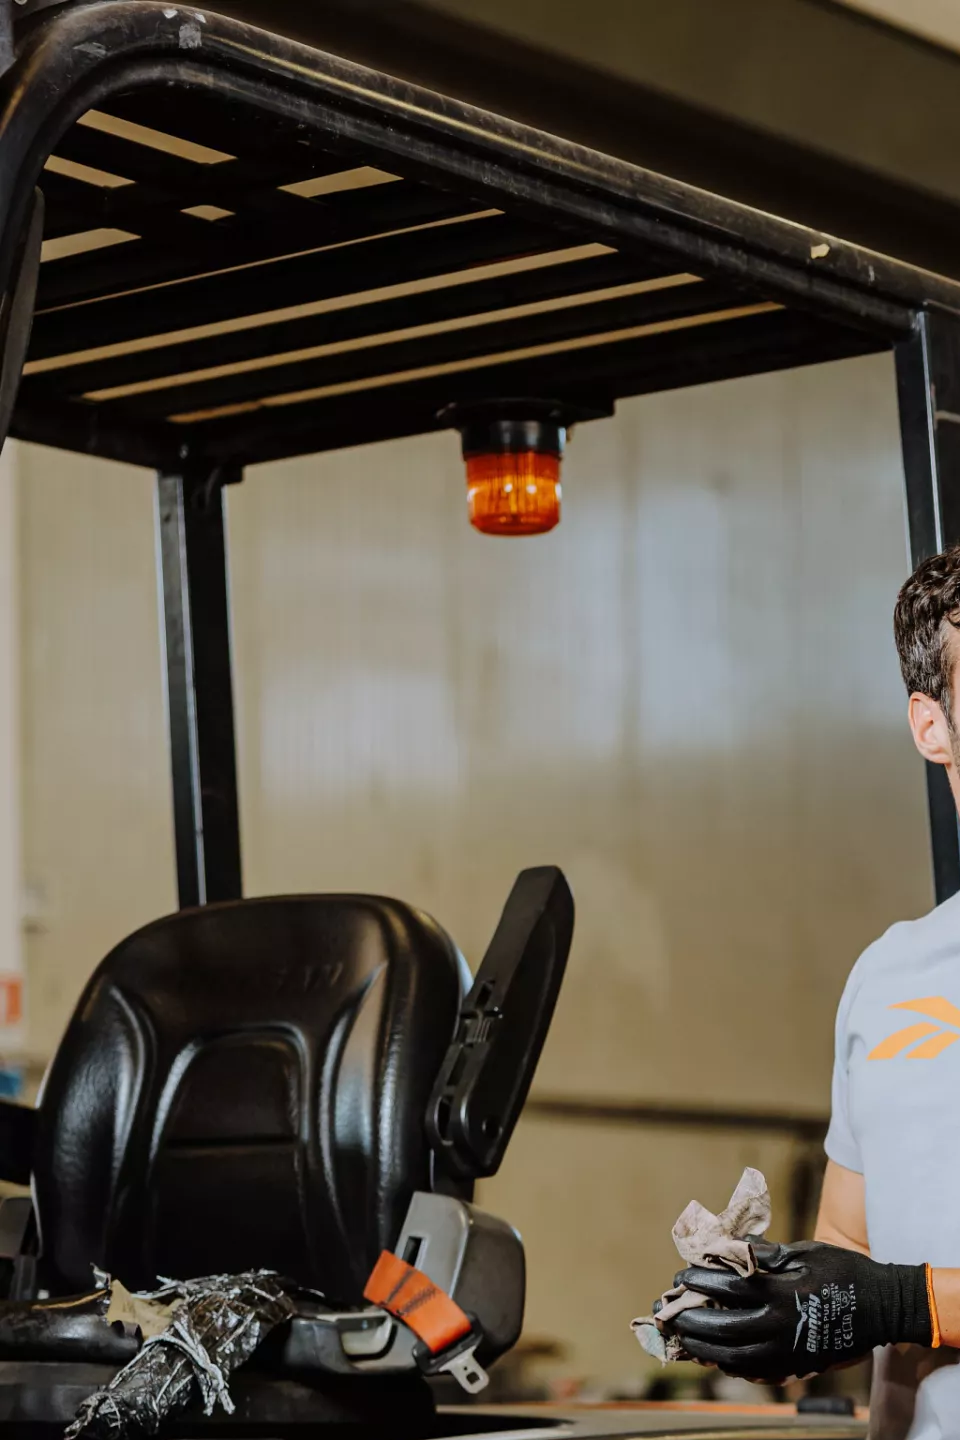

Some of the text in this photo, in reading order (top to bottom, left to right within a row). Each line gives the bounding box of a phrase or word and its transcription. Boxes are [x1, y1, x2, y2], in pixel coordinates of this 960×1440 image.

[822, 1288, 829, 1296] 9
[848, 1283, 857, 1312] 3121X
[822, 1323, 830, 1350] PULSE
